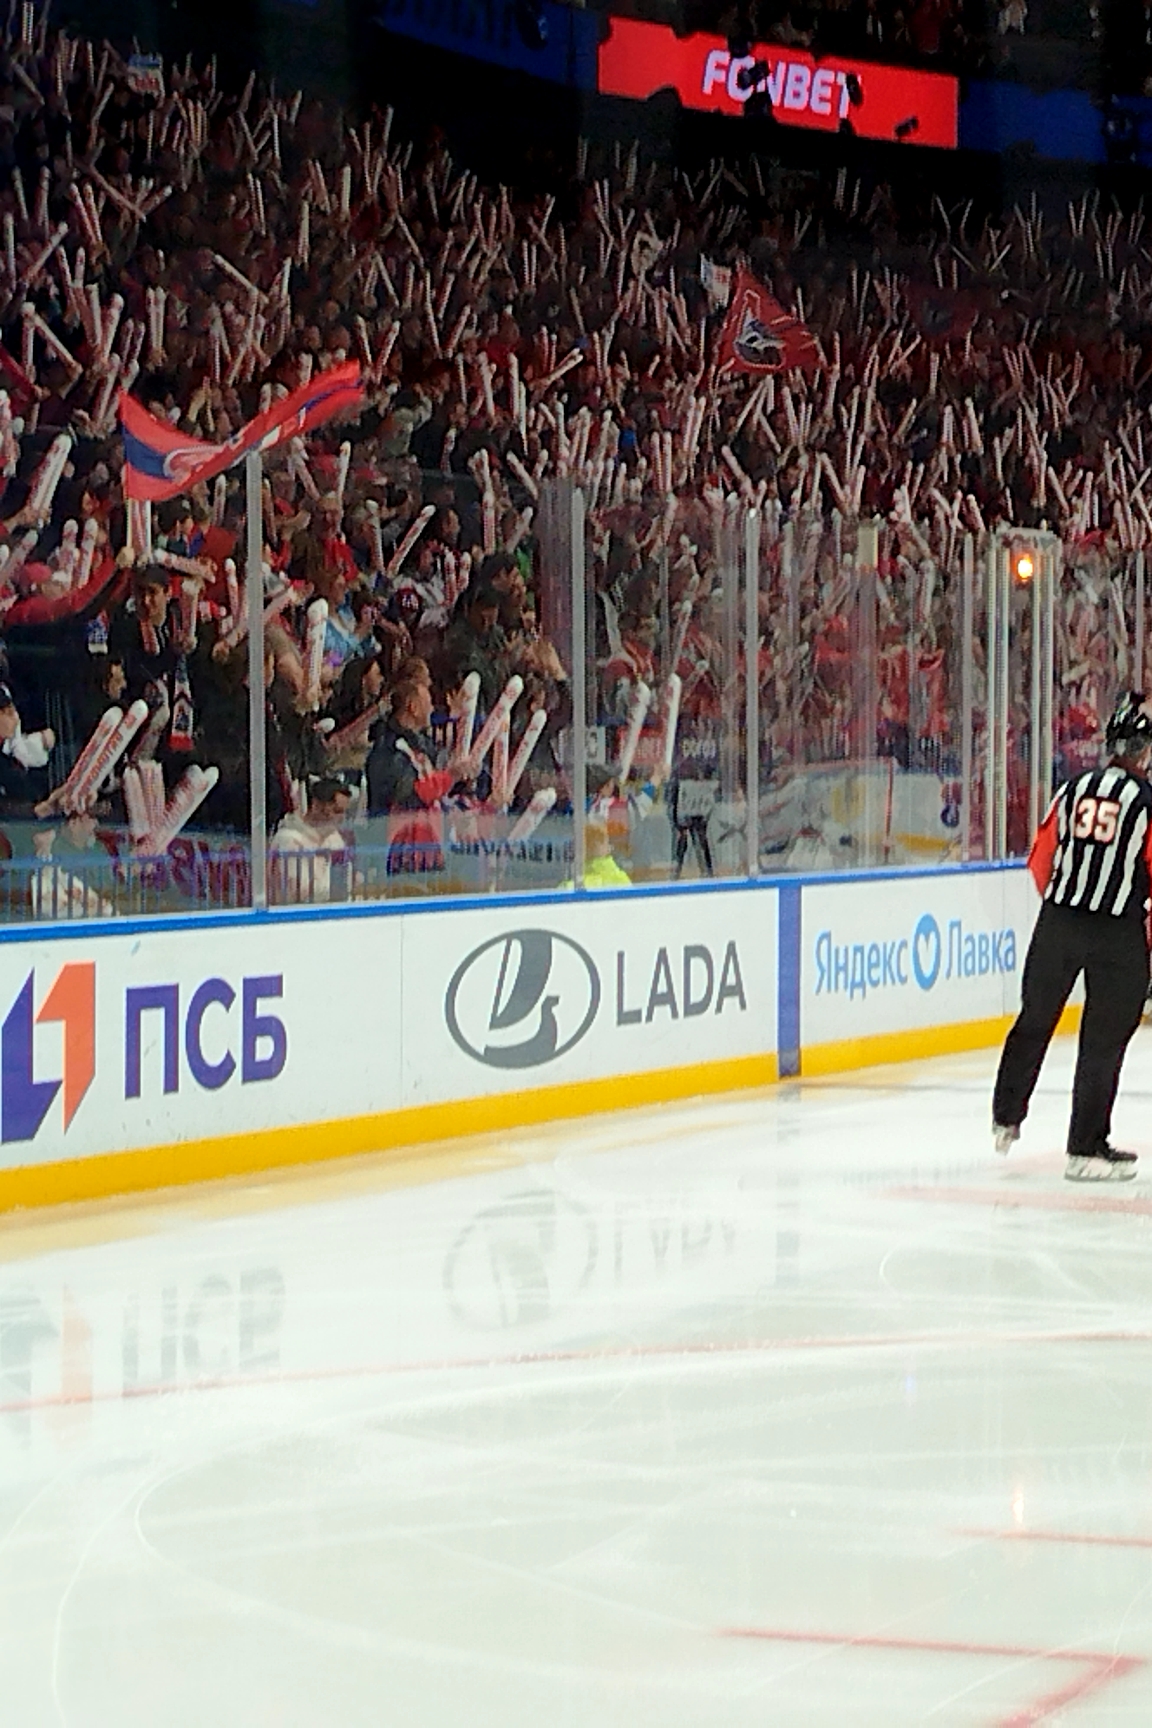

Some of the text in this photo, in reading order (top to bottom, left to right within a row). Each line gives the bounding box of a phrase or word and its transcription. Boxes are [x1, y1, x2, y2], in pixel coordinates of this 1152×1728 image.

[1074, 797, 1121, 843] 35
[615, 940, 748, 1027] LADA
[814, 917, 1017, 1002] Яндекс Лавка
[124, 973, 288, 1100] ПСБ
